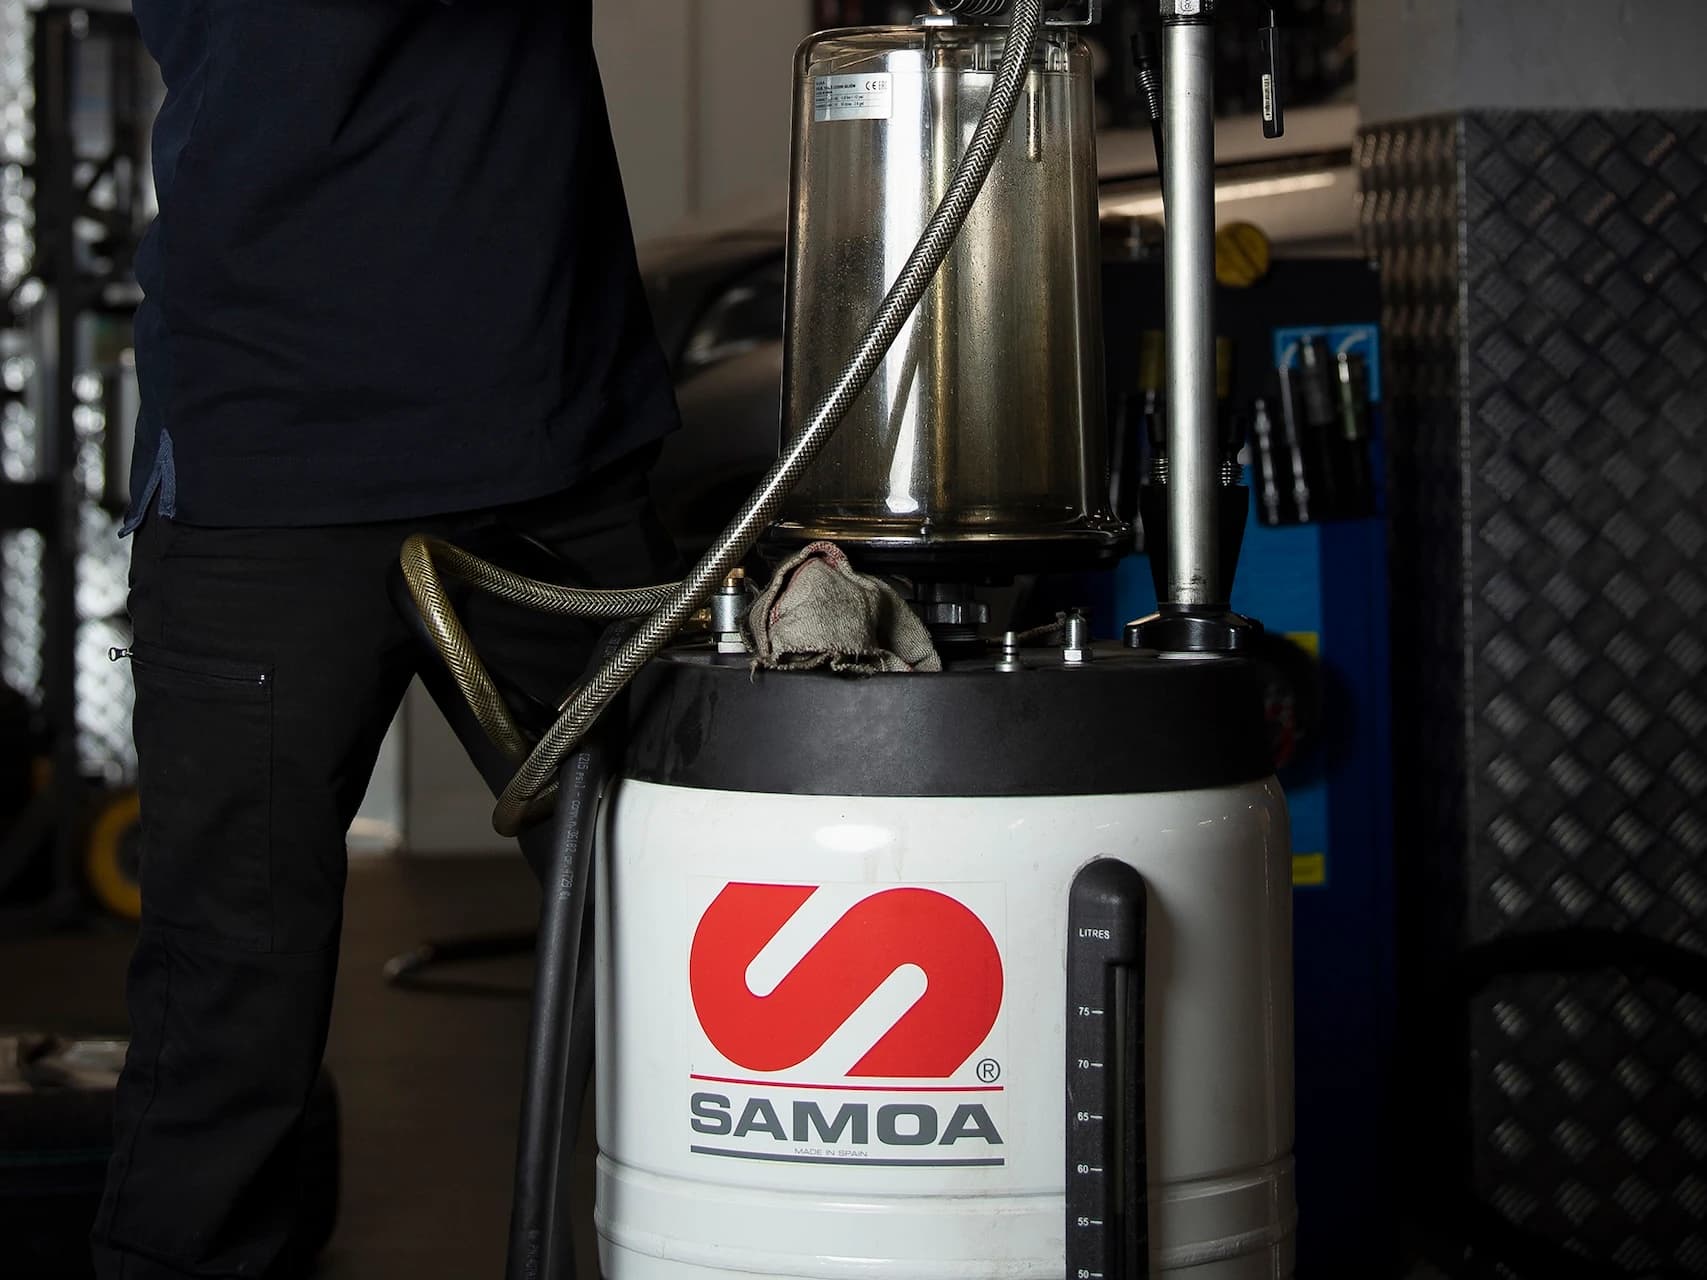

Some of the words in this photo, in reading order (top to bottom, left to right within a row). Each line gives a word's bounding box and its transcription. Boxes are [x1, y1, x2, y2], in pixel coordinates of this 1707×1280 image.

[1078, 927, 1110, 940] LITRES
[1078, 1006, 1090, 1016] 75
[1077, 1059, 1090, 1069] 70
[690, 1091, 1004, 1146] SAMOA
[1077, 1111, 1090, 1121] 65
[794, 1147, 823, 1156] MADE
[838, 1149, 868, 1157] SPAIN
[1076, 1164, 1089, 1174] 60
[1076, 1216, 1090, 1227] 55
[1077, 1269, 1090, 1280] 50
